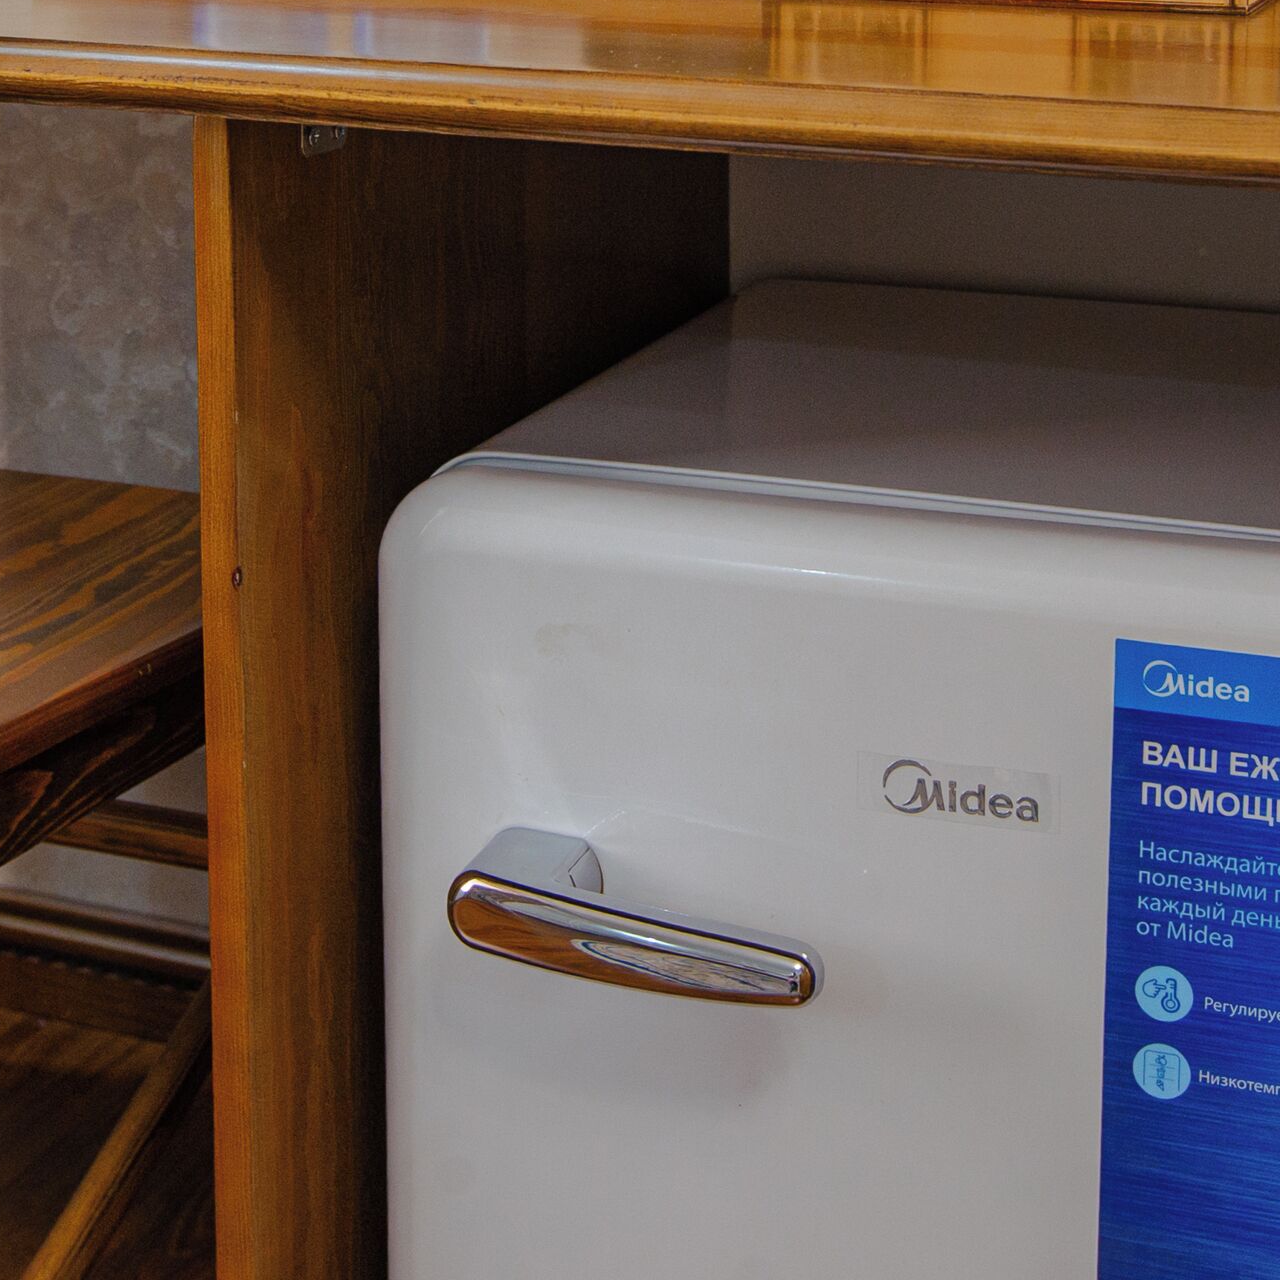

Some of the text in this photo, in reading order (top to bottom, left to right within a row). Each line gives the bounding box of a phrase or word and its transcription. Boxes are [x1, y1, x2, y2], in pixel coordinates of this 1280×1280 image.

[1143, 659, 1250, 703] Midea
[1142, 741, 1218, 774] ВАШ
[883, 759, 1039, 822] Midea
[1138, 870, 1267, 903] полезными
[1137, 895, 1226, 926] каждый
[1136, 921, 1235, 949] от Midea
